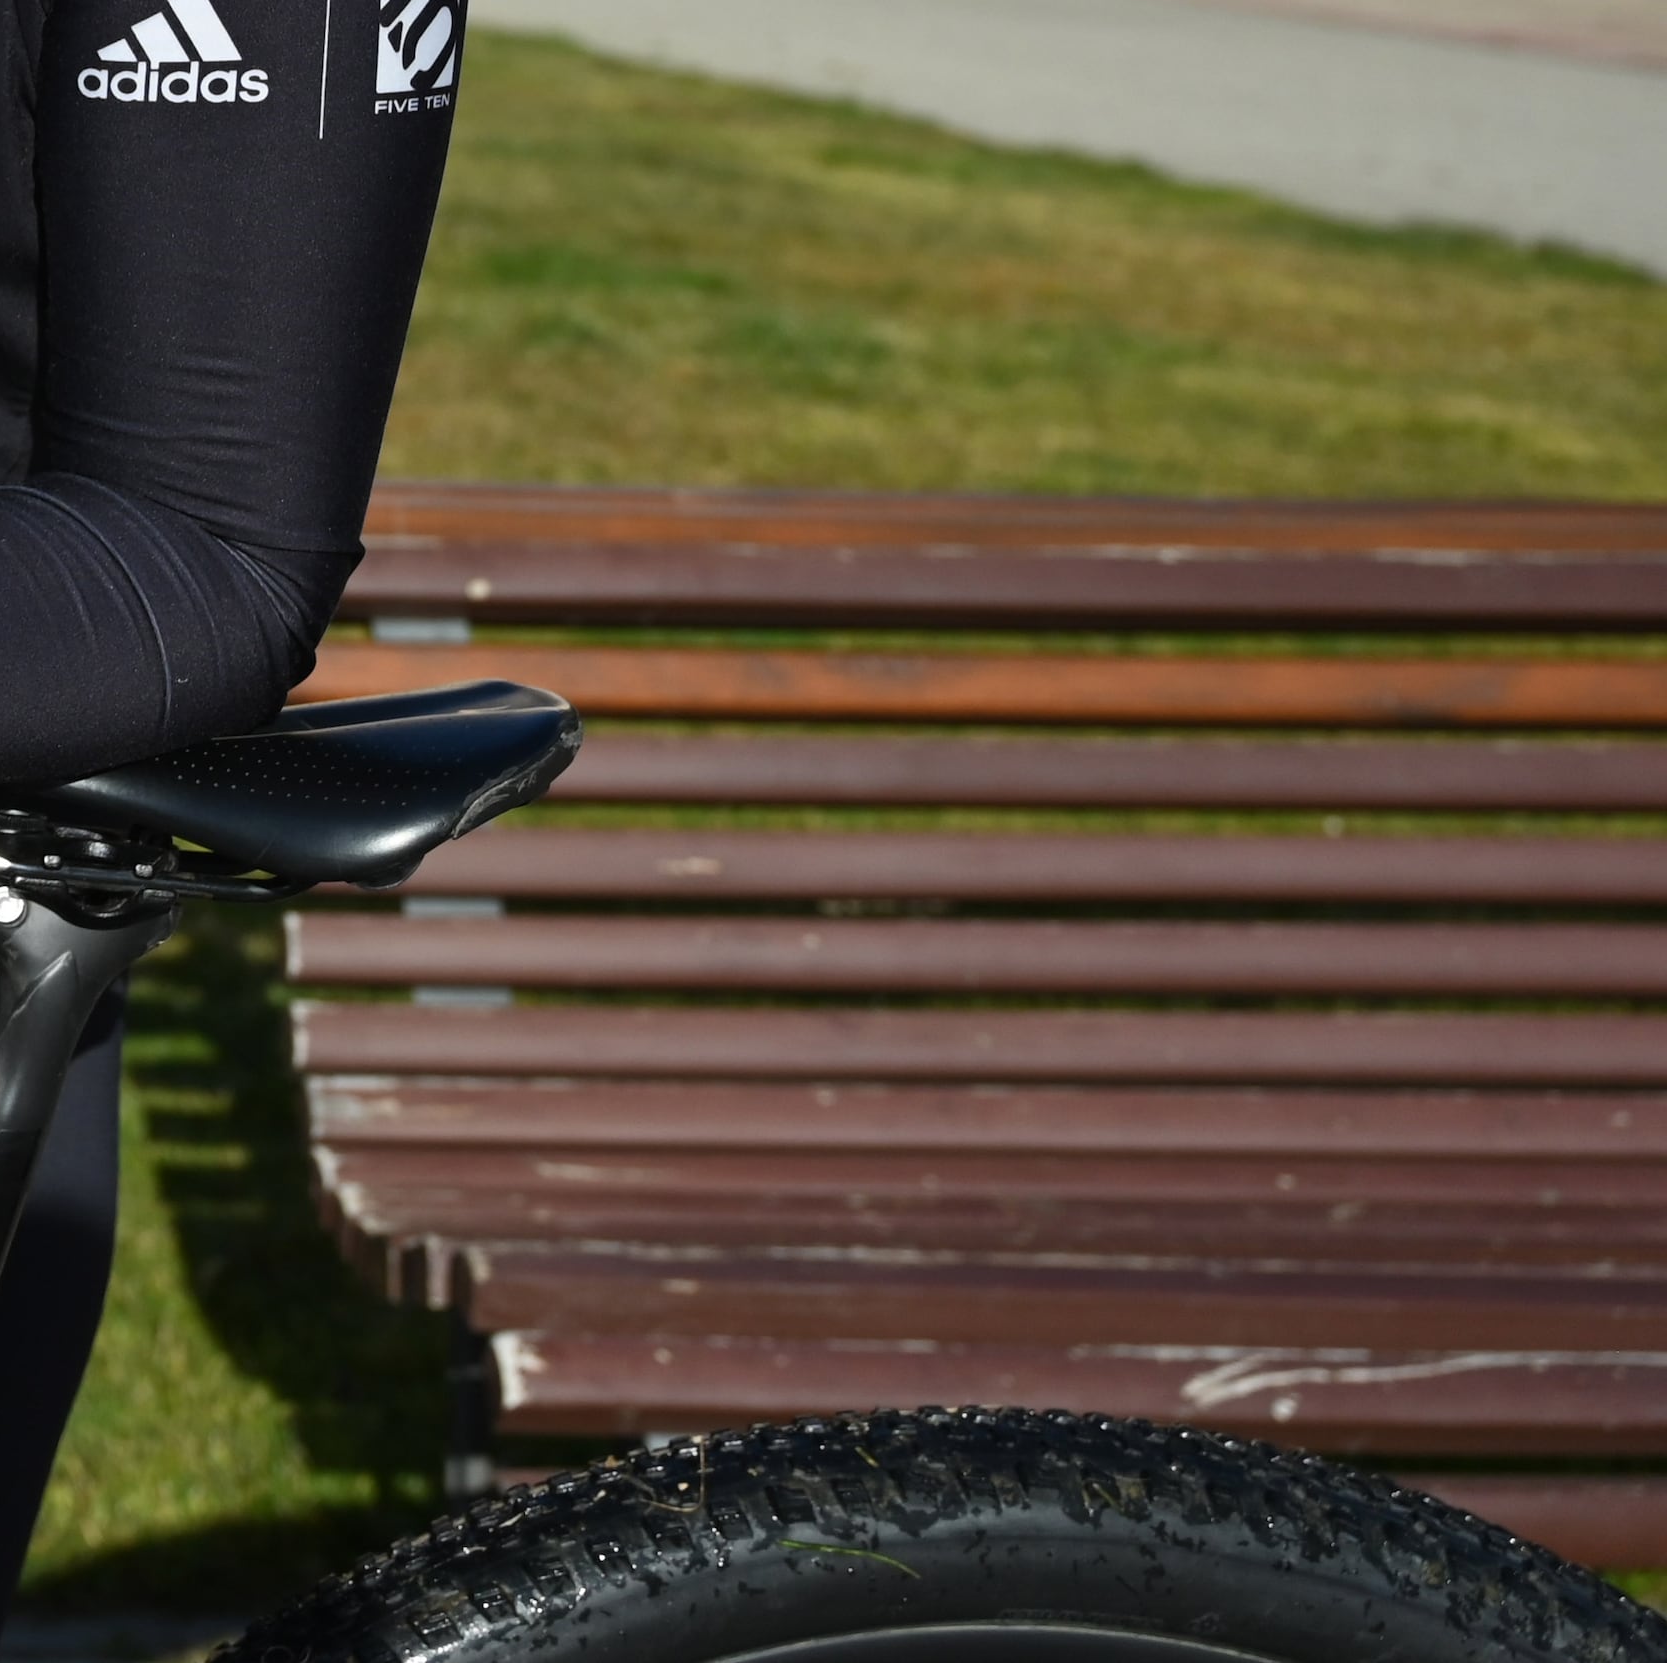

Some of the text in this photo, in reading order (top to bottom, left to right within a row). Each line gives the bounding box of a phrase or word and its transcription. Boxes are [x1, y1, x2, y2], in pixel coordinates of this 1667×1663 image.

[77, 61, 269, 103] adidas
[374, 93, 451, 115] FIVE TEN
